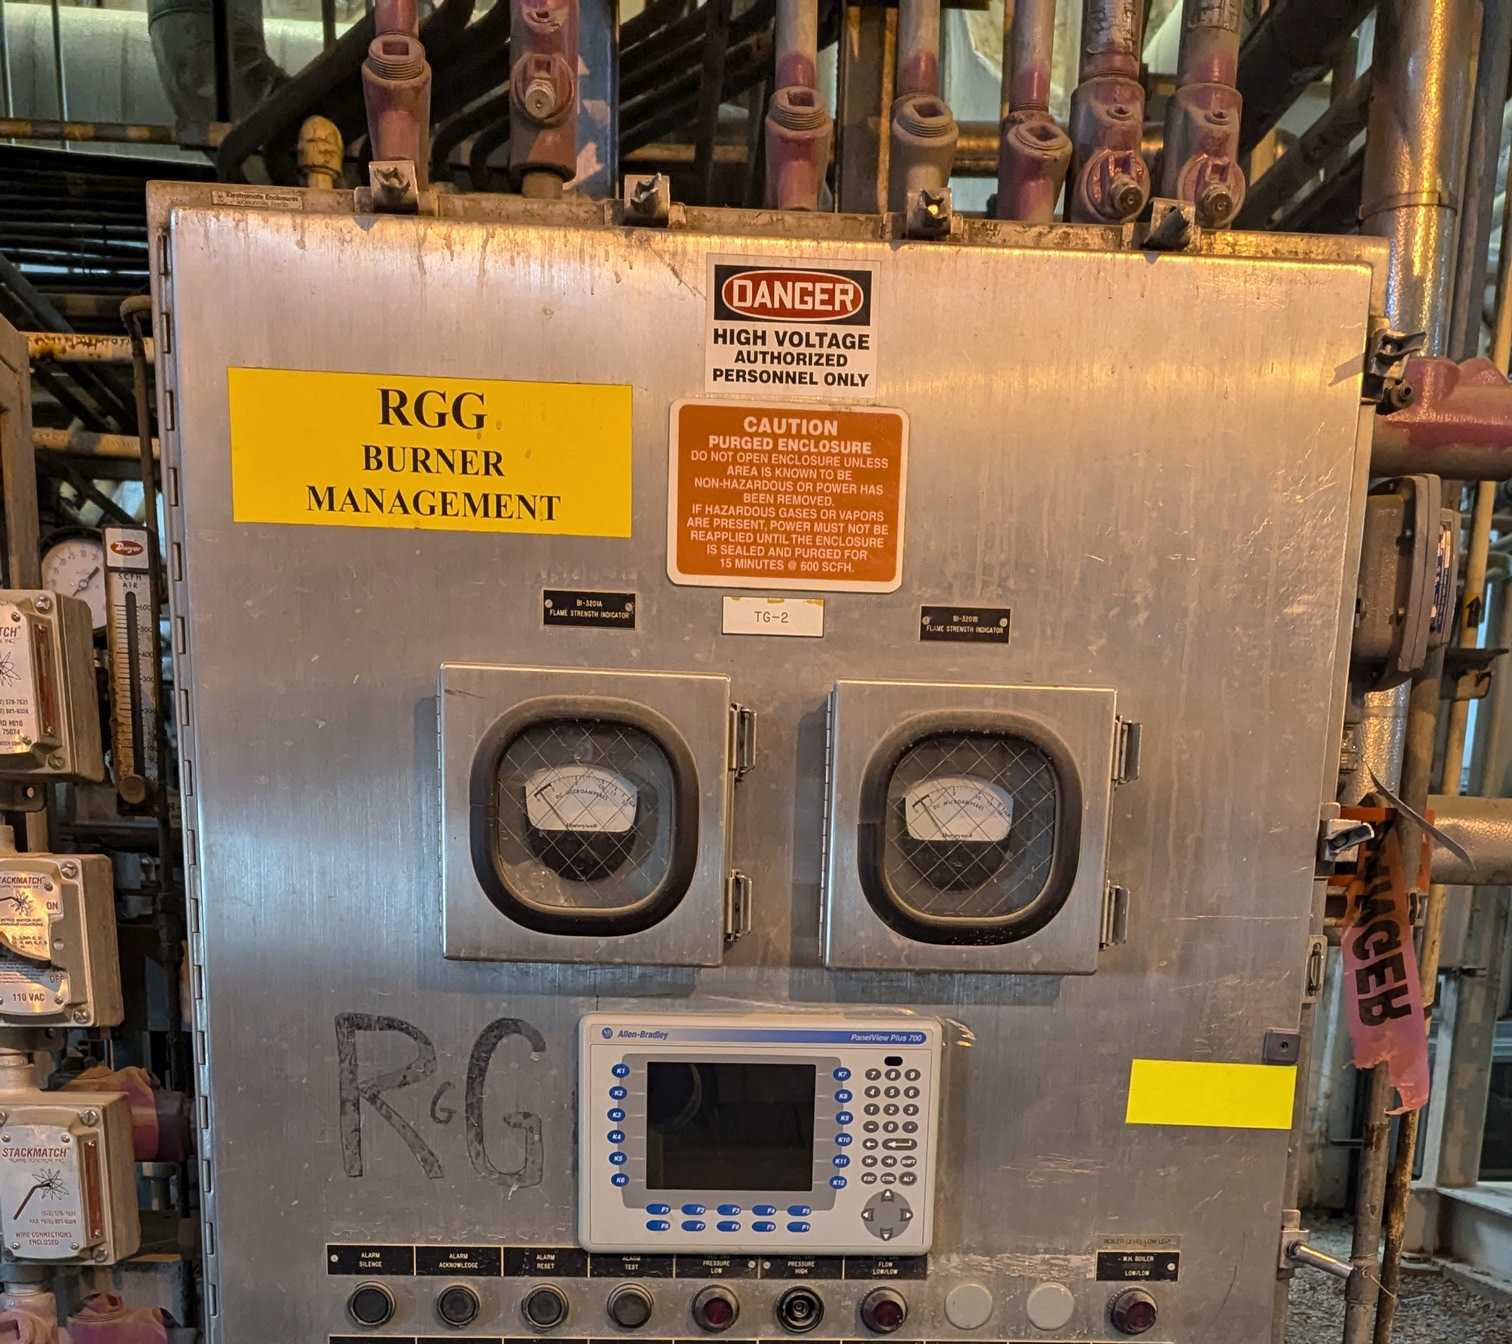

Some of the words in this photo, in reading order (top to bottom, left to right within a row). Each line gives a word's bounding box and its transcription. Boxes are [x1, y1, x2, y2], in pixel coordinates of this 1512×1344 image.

[732, 279, 854, 312] DANGER
[714, 328, 767, 346] HIGH
[774, 330, 870, 350] VOLTAGE
[734, 350, 848, 367] AUTHORIZED
[712, 368, 818, 386] PERSONNEL
[824, 372, 870, 388] ONLY
[377, 387, 488, 431] RGG
[743, 416, 839, 436] CAUTION
[708, 435, 773, 450] PURGED
[778, 438, 872, 455] ENCLOSURE
[360, 444, 505, 478] BURNER
[690, 450, 708, 462] DO
[710, 452, 733, 462] NOT
[736, 452, 768, 464] OPEN
[771, 454, 840, 467] ENCLOSURE
[844, 456, 889, 469] UNLESS
[726, 465, 758, 477] AREA
[760, 466, 772, 478] IS
[774, 467, 817, 480] KNOWN
[819, 469, 834, 480] TO
[837, 470, 852, 481] BE
[694, 476, 794, 492] NON-HAZARDOUS
[796, 480, 813, 492] OR
[816, 482, 857, 494] POWER
[860, 484, 884, 496] HAS
[305, 484, 562, 522] MANAGEMENT
[743, 492, 774, 504] BEEN
[777, 494, 836, 506] REMOVED.
[692, 504, 702, 514] IF
[704, 504, 776, 518] HAZARDOUS
[778, 506, 818, 520] GASES
[820, 508, 837, 520] OR
[838, 510, 884, 522] VAPORS
[686, 516, 710, 528] ARE
[770, 520, 811, 532] POWER
[814, 522, 844, 534] MUST
[848, 522, 870, 534] NOT
[874, 524, 889, 536] BE
[690, 530, 754, 544] REAPPLIED
[756, 532, 789, 546] UNTIL
[792, 534, 812, 546] THE
[815, 535, 884, 549] ENCLOSURE
[706, 544, 718, 554] IS
[720, 544, 765, 556] SEALED
[768, 546, 792, 558] AND
[794, 546, 842, 560] PURGED
[844, 548, 868, 561] FOR
[720, 558, 732, 569] 15
[734, 558, 784, 571] MINUTES
[800, 560, 819, 572] 600
[822, 562, 856, 574] SCFH.
[549, 608, 568, 616] FLAME
[570, 610, 599, 618] STRENGTH
[600, 611, 630, 619] INDICATOR
[754, 610, 790, 624] TG-2
[926, 624, 944, 632] FLAME
[946, 625, 974, 634] STRENGTH
[976, 626, 1004, 634] INDICATOR
[0, 876, 42, 885] ACKMATCH
[46, 901, 59, 910] ON
[12, 992, 26, 1002] 110
[28, 992, 46, 1002] VAC
[617, 1030, 668, 1040] Allen-Bradley
[2, 1148, 68, 1158] STACKMATCH
